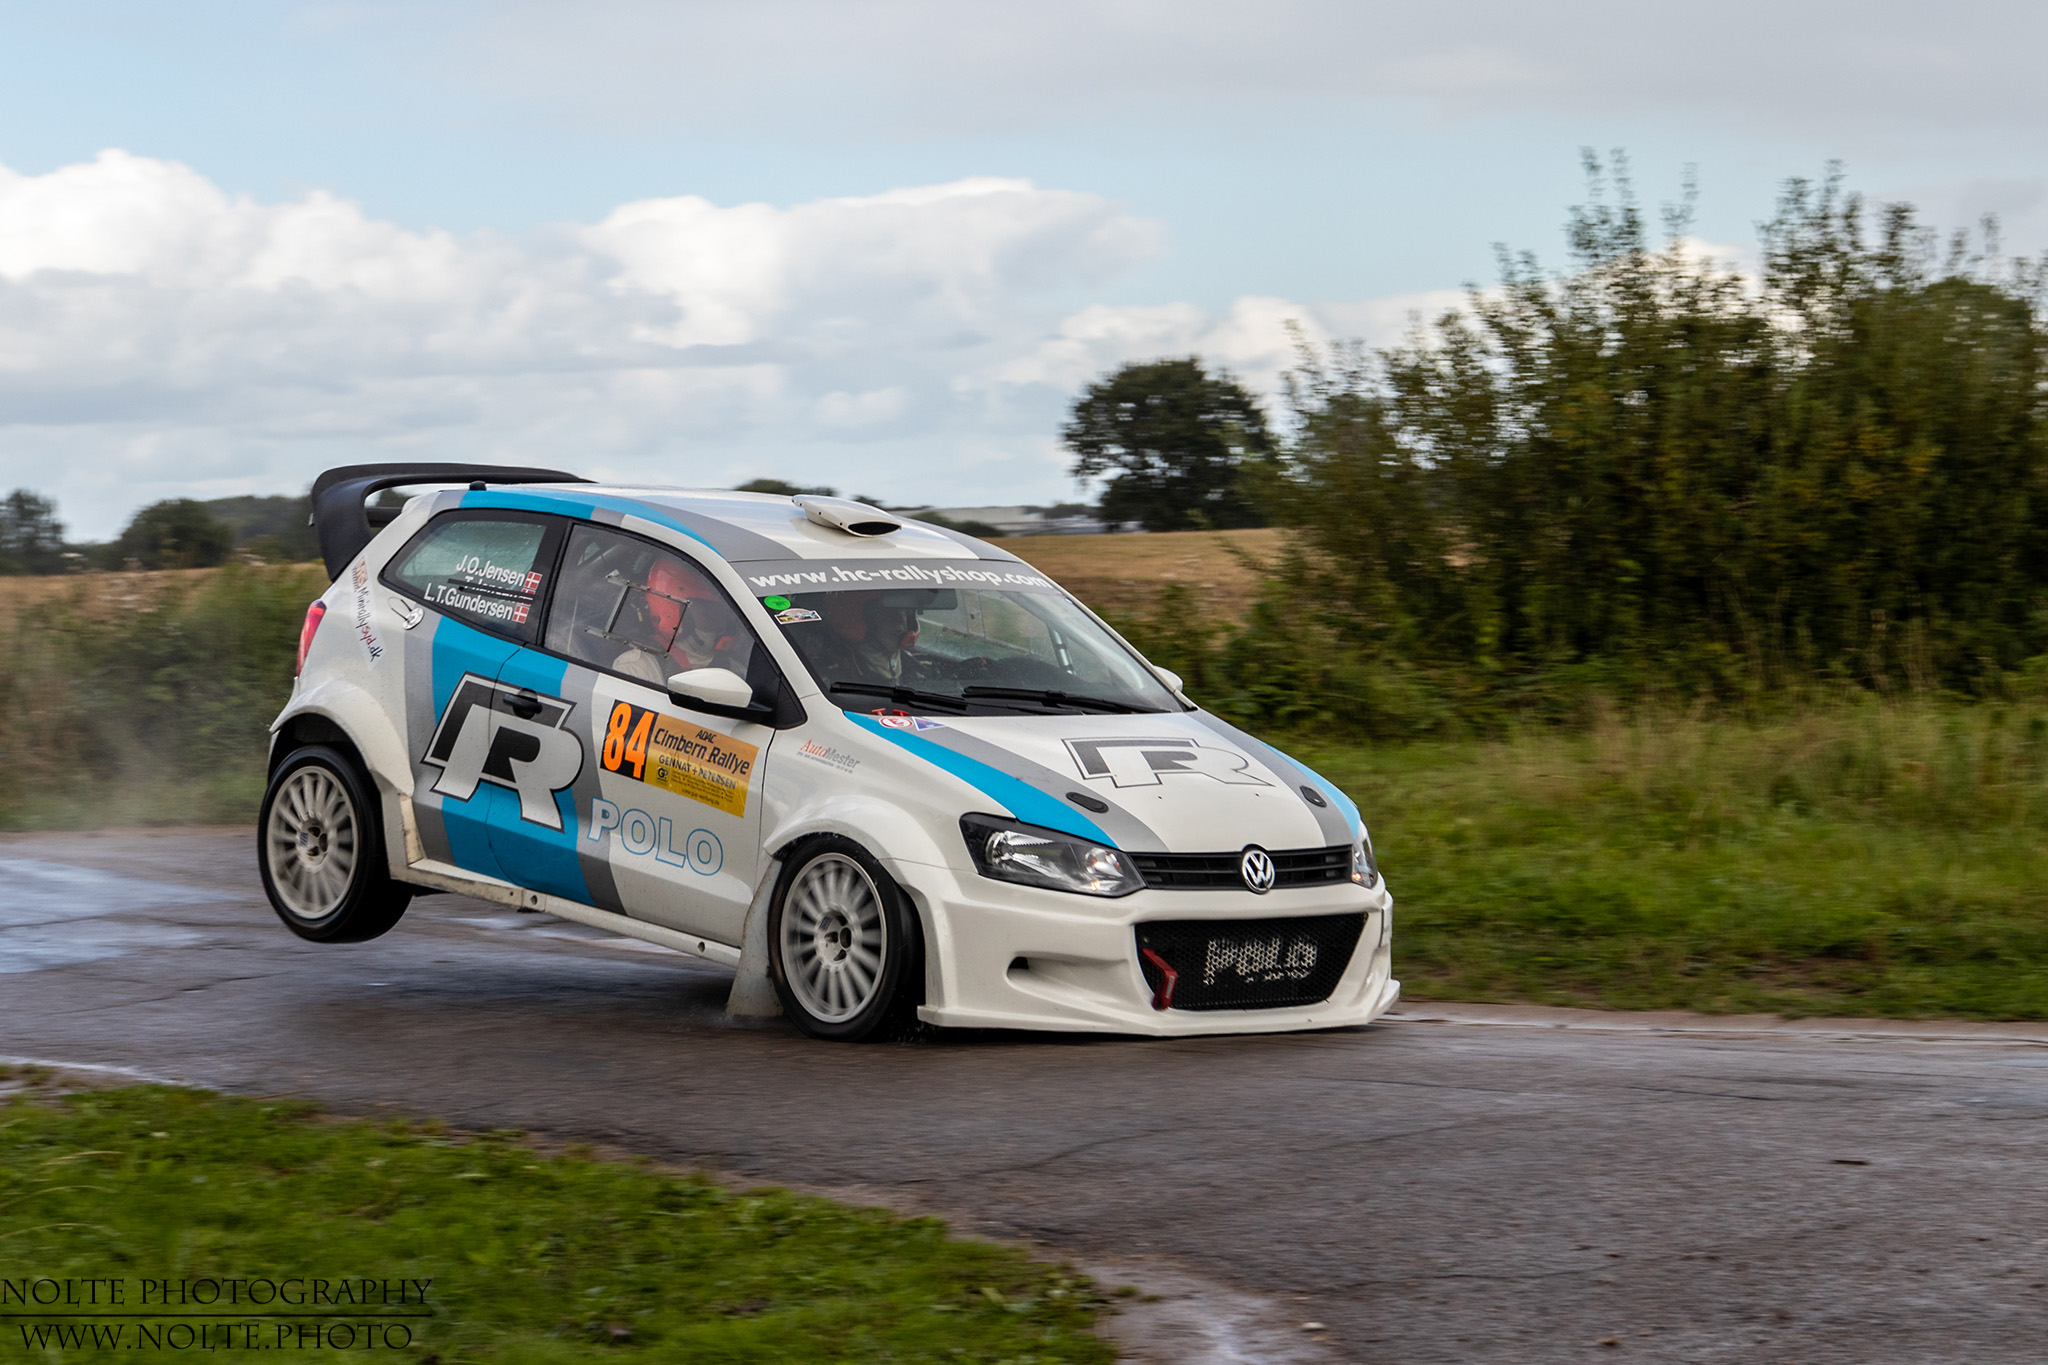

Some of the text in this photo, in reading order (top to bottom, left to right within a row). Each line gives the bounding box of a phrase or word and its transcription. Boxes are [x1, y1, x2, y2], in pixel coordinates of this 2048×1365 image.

[456, 554, 526, 587] J.O.Jensen
[748, 565, 1052, 592] www.hc-rallyshop.com
[423, 582, 513, 622] L.T.Gundersen
[420, 671, 584, 834] R
[602, 702, 656, 779] 84
[652, 728, 751, 776] Cimbern Rallye
[695, 729, 718, 744] ADAC
[658, 754, 691, 774] GENNAT
[697, 767, 737, 790] PETERSEN
[587, 796, 724, 877] POLO
[1202, 936, 1318, 986] POLO
